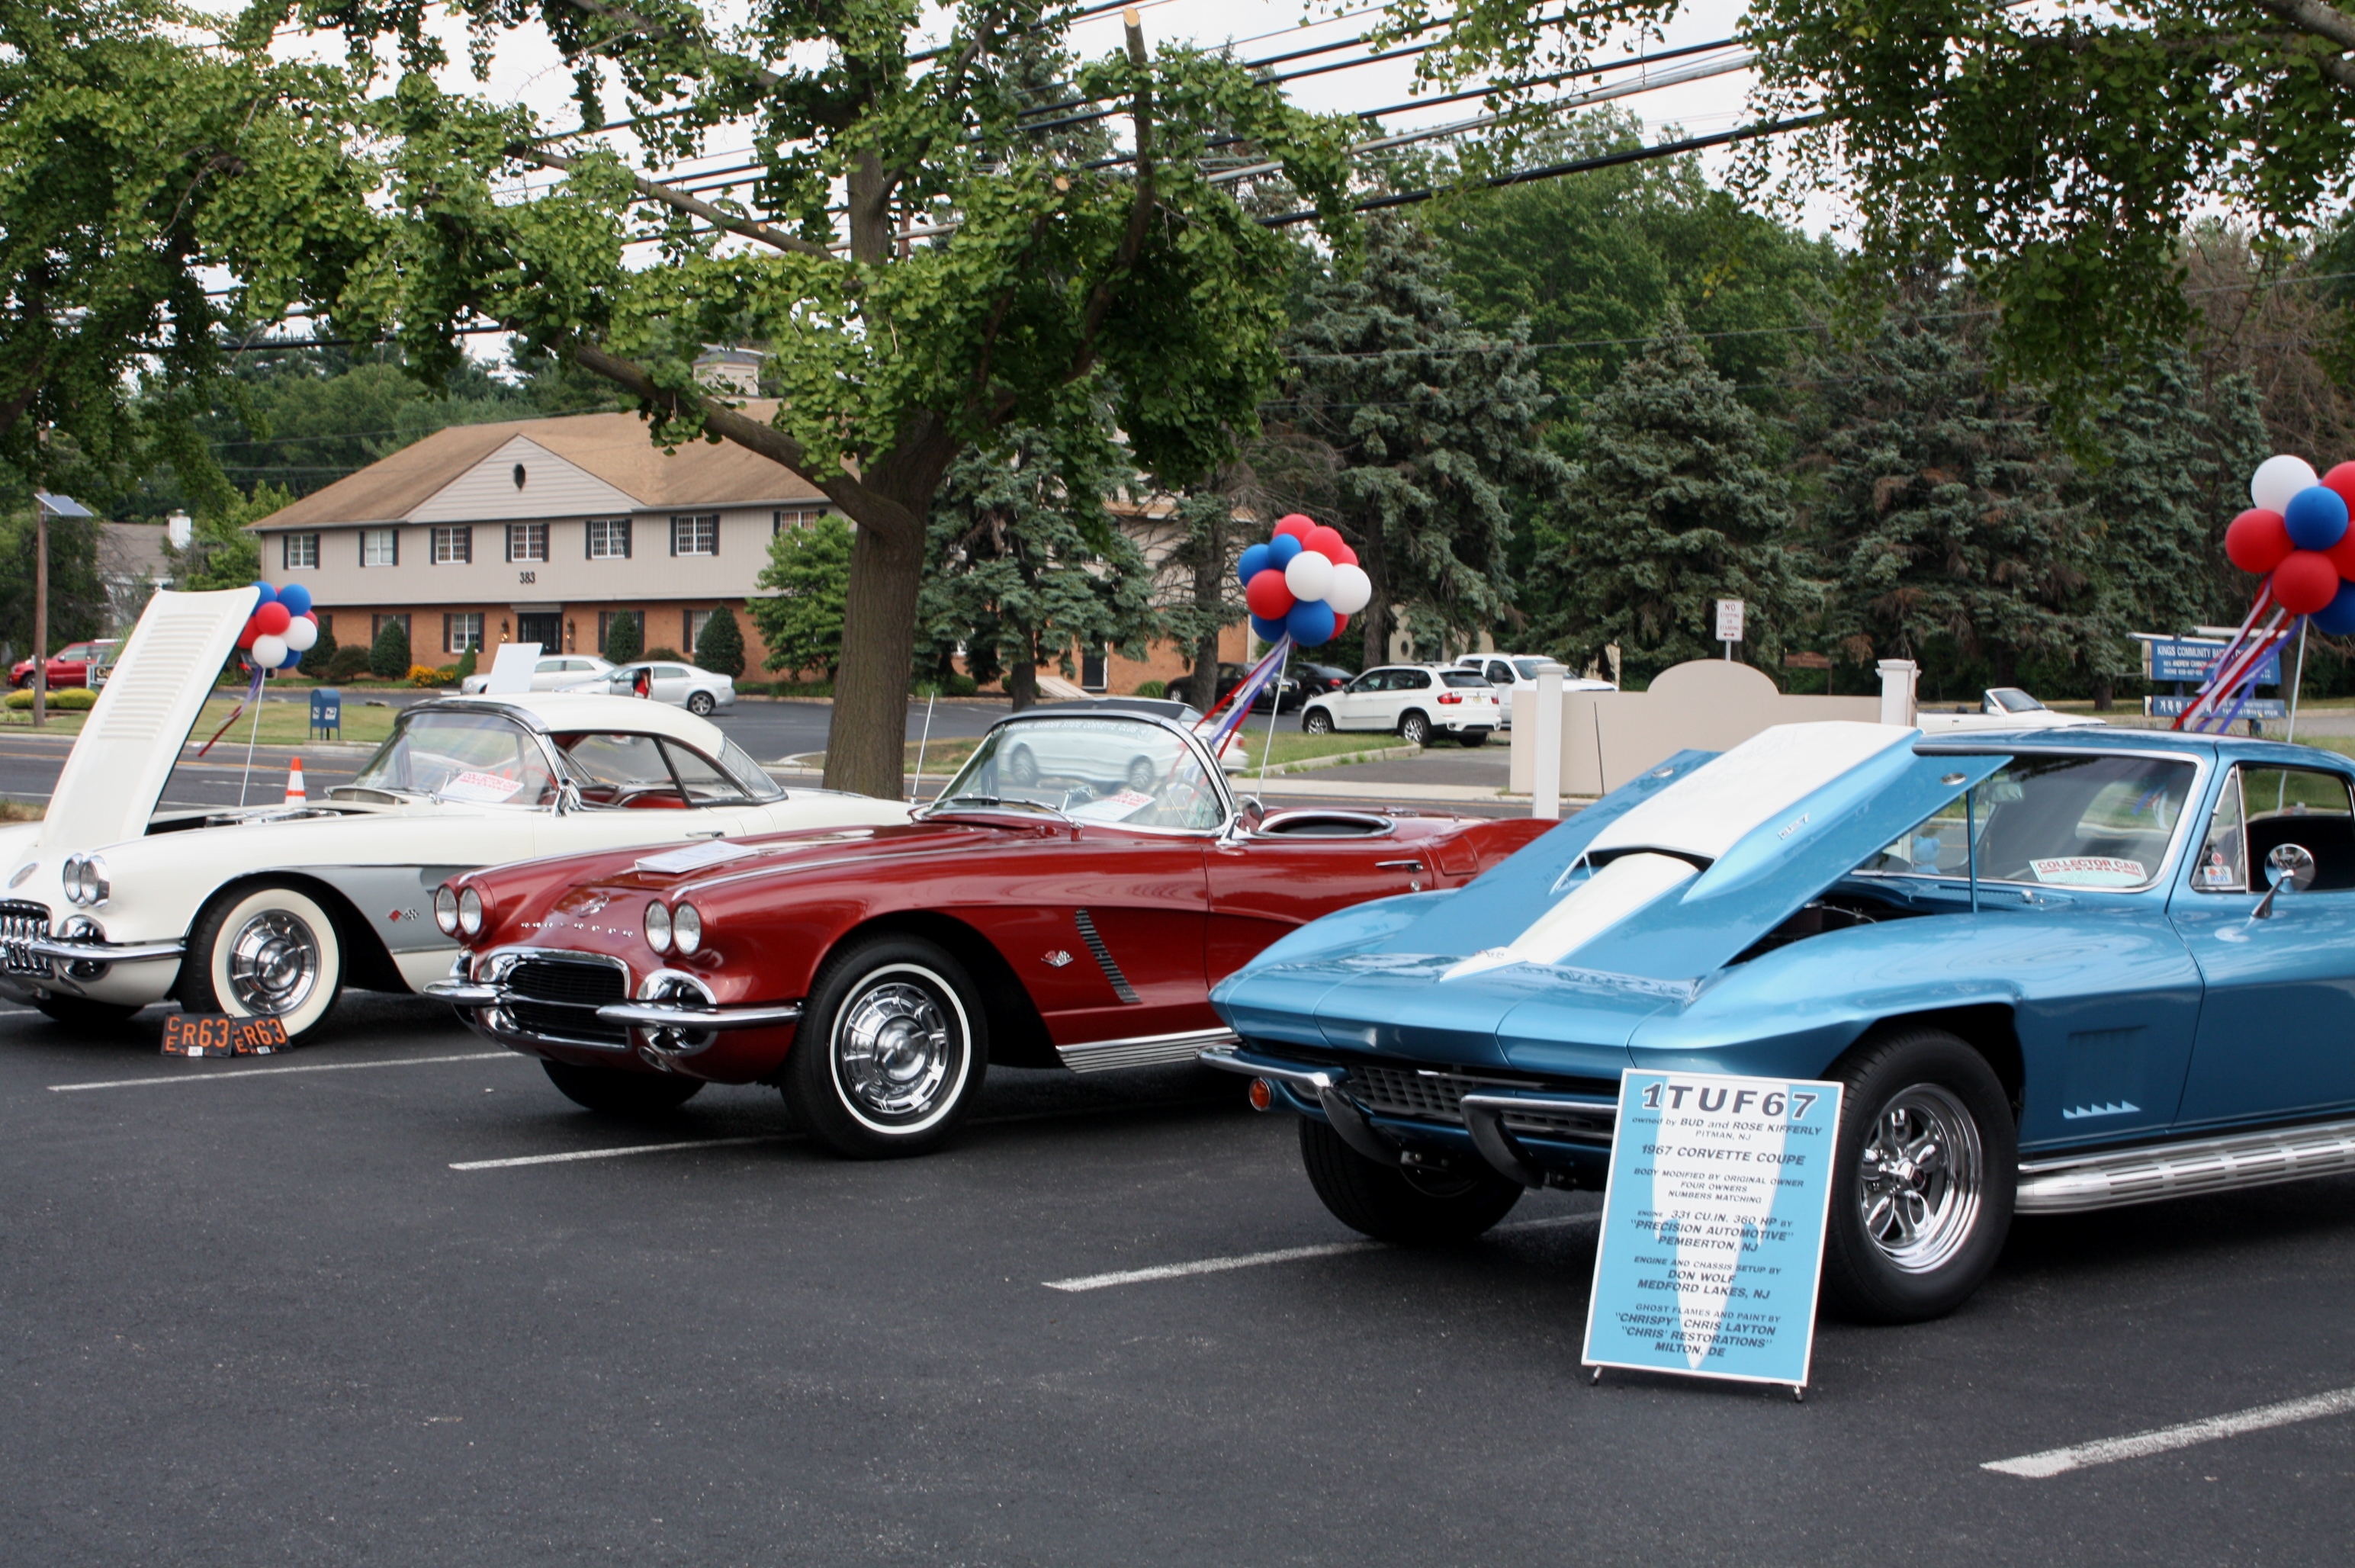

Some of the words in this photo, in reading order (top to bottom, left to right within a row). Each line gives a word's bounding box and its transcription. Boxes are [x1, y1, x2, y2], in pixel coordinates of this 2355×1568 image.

[519, 571, 535, 584] 383
[2157, 645, 2176, 656] KINGS
[2177, 646, 2211, 658] COMMUNITY
[2037, 859, 2112, 869] COLLECTOR
[2114, 860, 2139, 872] CAR
[1643, 1082, 1817, 1121] 1TUF67
[1632, 1117, 1663, 1125] owned
[1666, 1118, 1677, 1126] by
[1680, 1117, 1704, 1127] BUD
[1708, 1120, 1730, 1129] and
[1733, 1121, 1765, 1132] ROSE
[1767, 1123, 1823, 1136] KIFFERLY
[1695, 1129, 1735, 1140] PITMAN,
[1642, 1144, 1673, 1155] 1967
[1677, 1146, 1753, 1162] CORVETTE
[1756, 1152, 1806, 1166] COUPE
[1662, 1170, 1706, 1180] MODIFIED
[1724, 1174, 1767, 1185] ORIGINAL
[1770, 1178, 1804, 1187] OWNER
[1680, 1181, 1706, 1190] FOUR
[1708, 1183, 1748, 1193] OWNERS
[1668, 1190, 1713, 1200] NUMBERS
[1715, 1193, 1762, 1204] MATCHING
[1671, 1210, 1691, 1219] 331
[1733, 1215, 1756, 1225] 360
[1760, 1216, 1778, 1226] HP
[1780, 1219, 1794, 1228] BY
[1658, 1235, 1737, 1252] PEMBERTON,
[1742, 1242, 1758, 1252] NJ
[1634, 1255, 1668, 1265] ENGINE
[1693, 1261, 1733, 1271] CHASSIS
[1736, 1264, 1766, 1274] SETUP
[1668, 1269, 1695, 1280] DON
[1701, 1272, 1737, 1284] WOLF
[1637, 1279, 1699, 1293] MEDFORD
[1703, 1285, 1749, 1299] LAKES,
[1753, 1289, 1771, 1300] NJ
[1636, 1303, 1669, 1313] GHOST
[1672, 1306, 1711, 1317] FLAMES
[1714, 1310, 1734, 1319] AND
[1737, 1313, 1767, 1322] PAINT
[1684, 1319, 1721, 1331] CHRIS
[1725, 1322, 1776, 1336] LAYTON
[1654, 1341, 1703, 1356] MILTON,
[1708, 1347, 1726, 1357] DE
